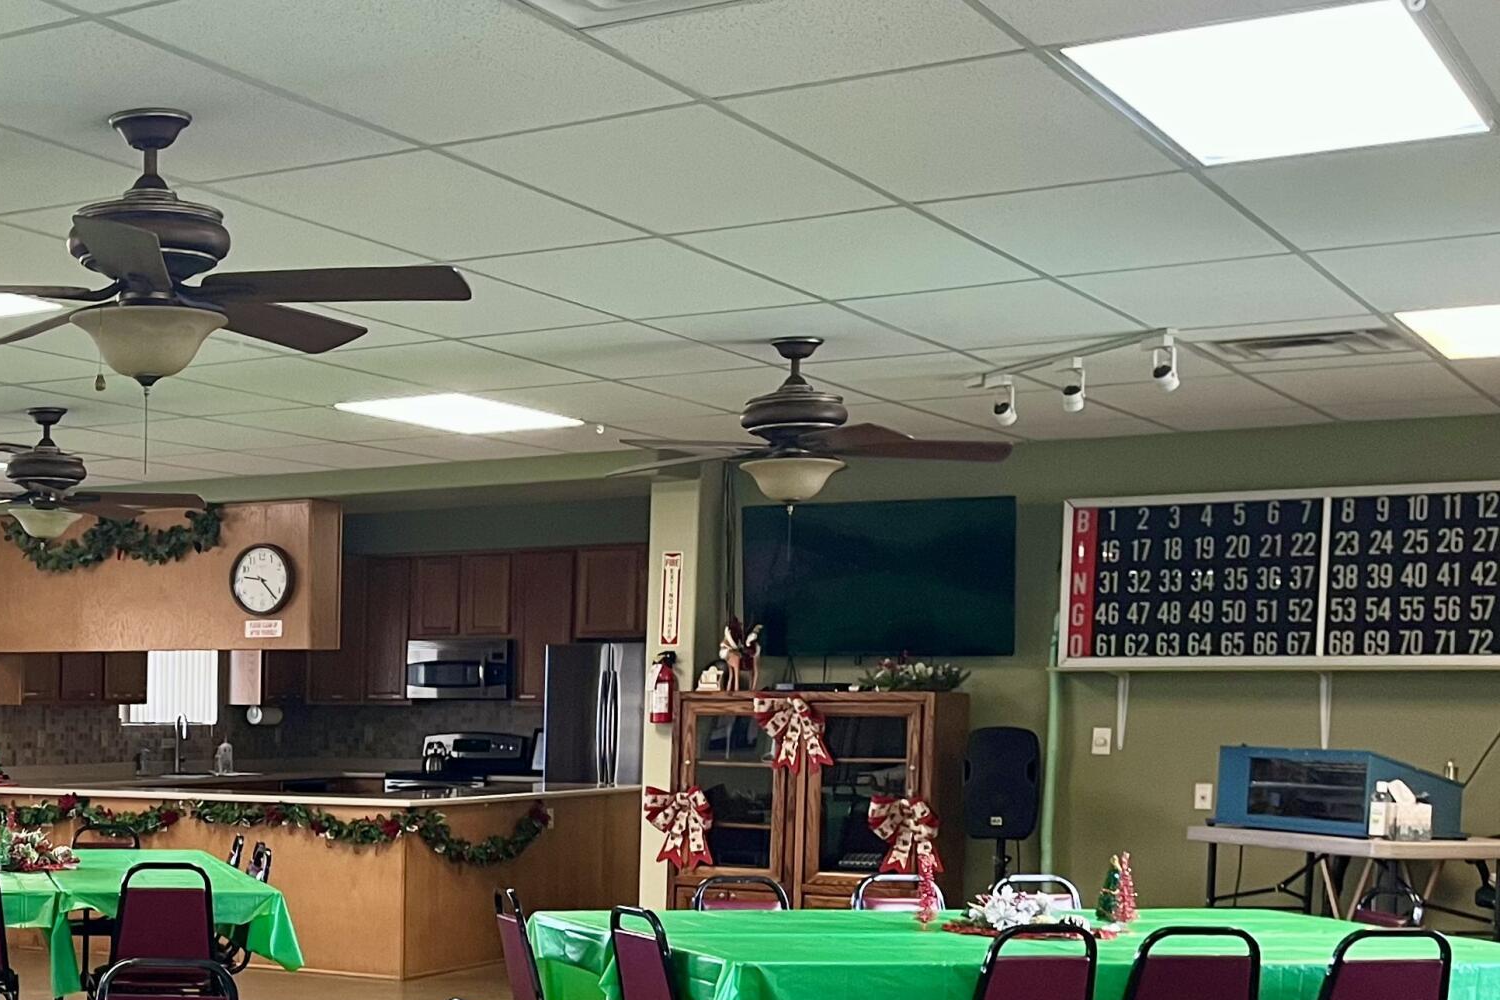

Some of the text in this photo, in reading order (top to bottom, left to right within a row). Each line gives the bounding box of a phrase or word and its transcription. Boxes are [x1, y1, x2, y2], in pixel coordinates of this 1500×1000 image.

[1077, 492, 1499, 533] B 1 2 3 4 5 6 7 8 9 10 11 12
[1101, 540, 1120, 563] 16
[1132, 538, 1151, 562] 17
[1164, 537, 1182, 560] 18
[1195, 536, 1214, 559] 19
[1225, 535, 1250, 559] 20
[1259, 534, 1282, 557] 21
[1290, 532, 1316, 557] 22
[1334, 530, 1359, 556] 23
[1368, 530, 1394, 555] 24
[1402, 529, 1429, 554] 25
[1436, 527, 1464, 553] 26
[1472, 526, 1499, 552] 27
[1073, 560, 1498, 594] N 31 32 33 34 35 36 37 38 39 40 41 42
[1072, 595, 1496, 626] G 46 47 48 49 50 51 52 53 54 55 56 57
[1070, 629, 1494, 657] O 61 62 63 64 65 66 67 68 69 70 71 72
